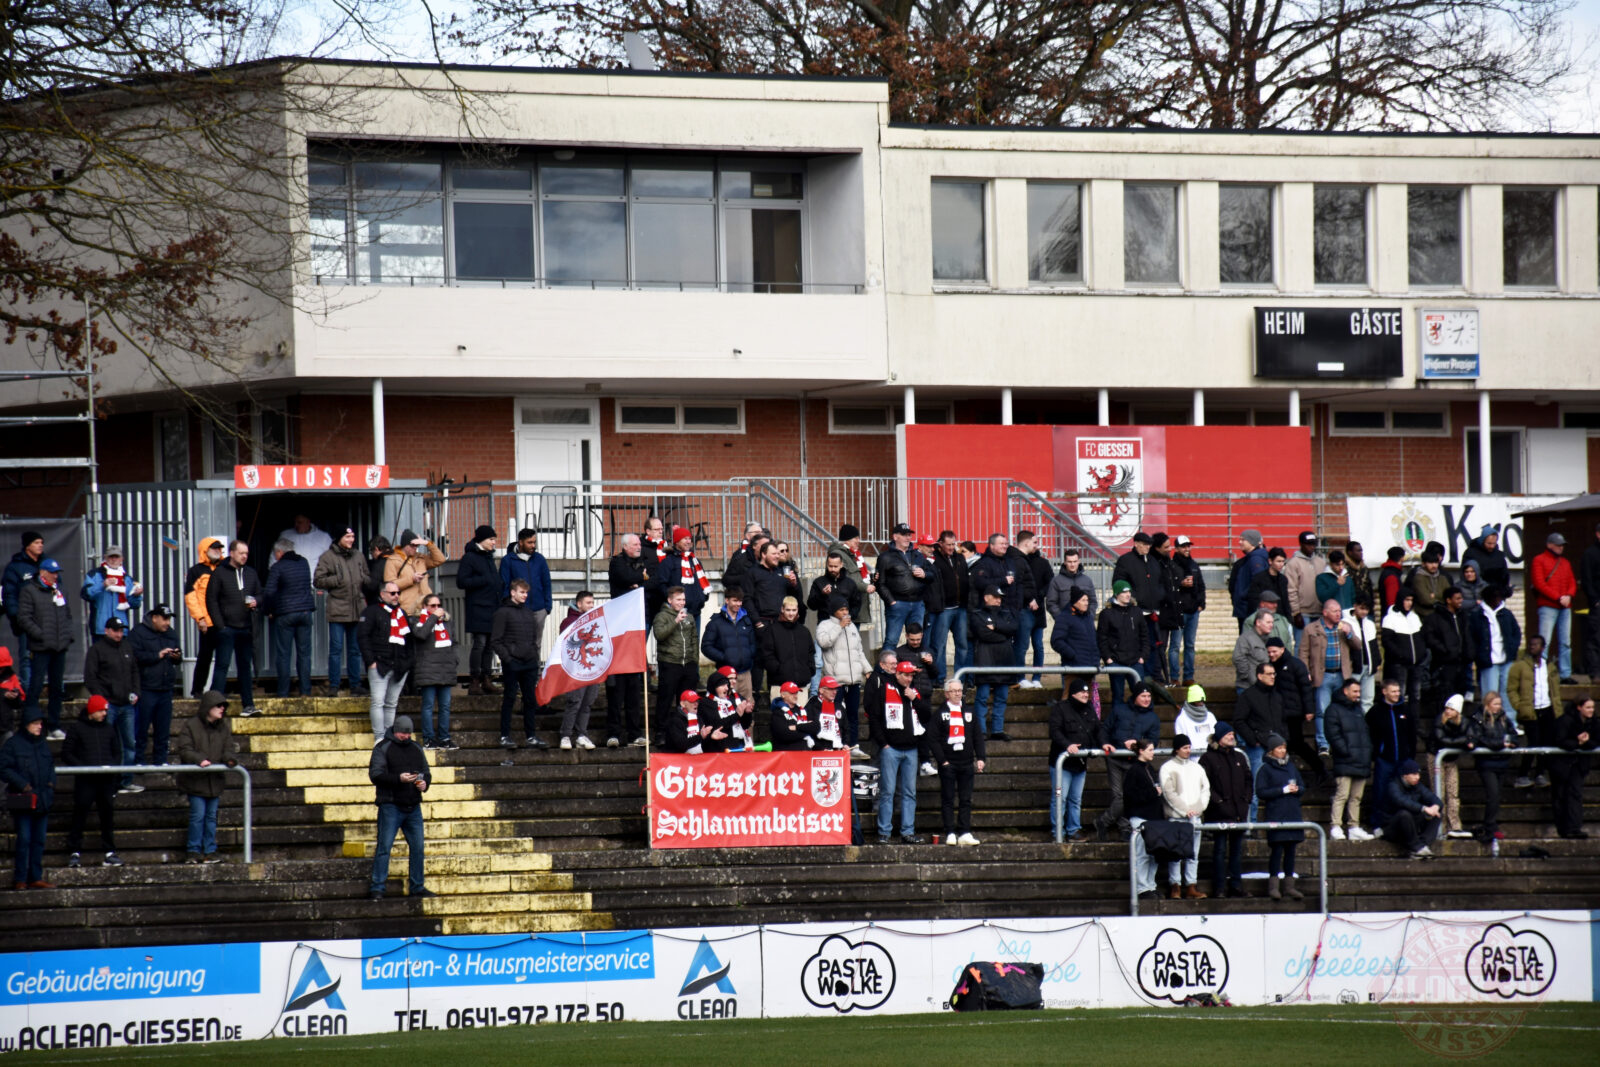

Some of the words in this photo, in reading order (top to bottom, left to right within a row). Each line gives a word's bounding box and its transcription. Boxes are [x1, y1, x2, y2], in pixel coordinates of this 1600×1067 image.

[1265, 311, 1305, 335] HEIM
[1350, 308, 1402, 336] GÄSTE
[1085, 442, 1096, 456] FC
[1097, 442, 1134, 456] GIESSEN
[275, 467, 350, 487] KIOSK
[655, 765, 805, 799] Giessener
[656, 807, 844, 841] Schlammbeiser
[367, 953, 442, 980] Garten-
[445, 953, 461, 976] &
[464, 948, 651, 976] Hausmeisterservice
[818, 958, 878, 978] PASTA
[1154, 951, 1211, 970] PASTA
[1481, 946, 1540, 967] PASTA
[7, 966, 206, 995] Gebäudereinigung
[394, 1009, 439, 1032] TEL.
[446, 1005, 549, 1029] 0641-972
[555, 1004, 590, 1023] 172
[596, 1002, 624, 1022] 50
[678, 998, 738, 1020] CLEAN
[282, 1014, 348, 1037] CLEAN
